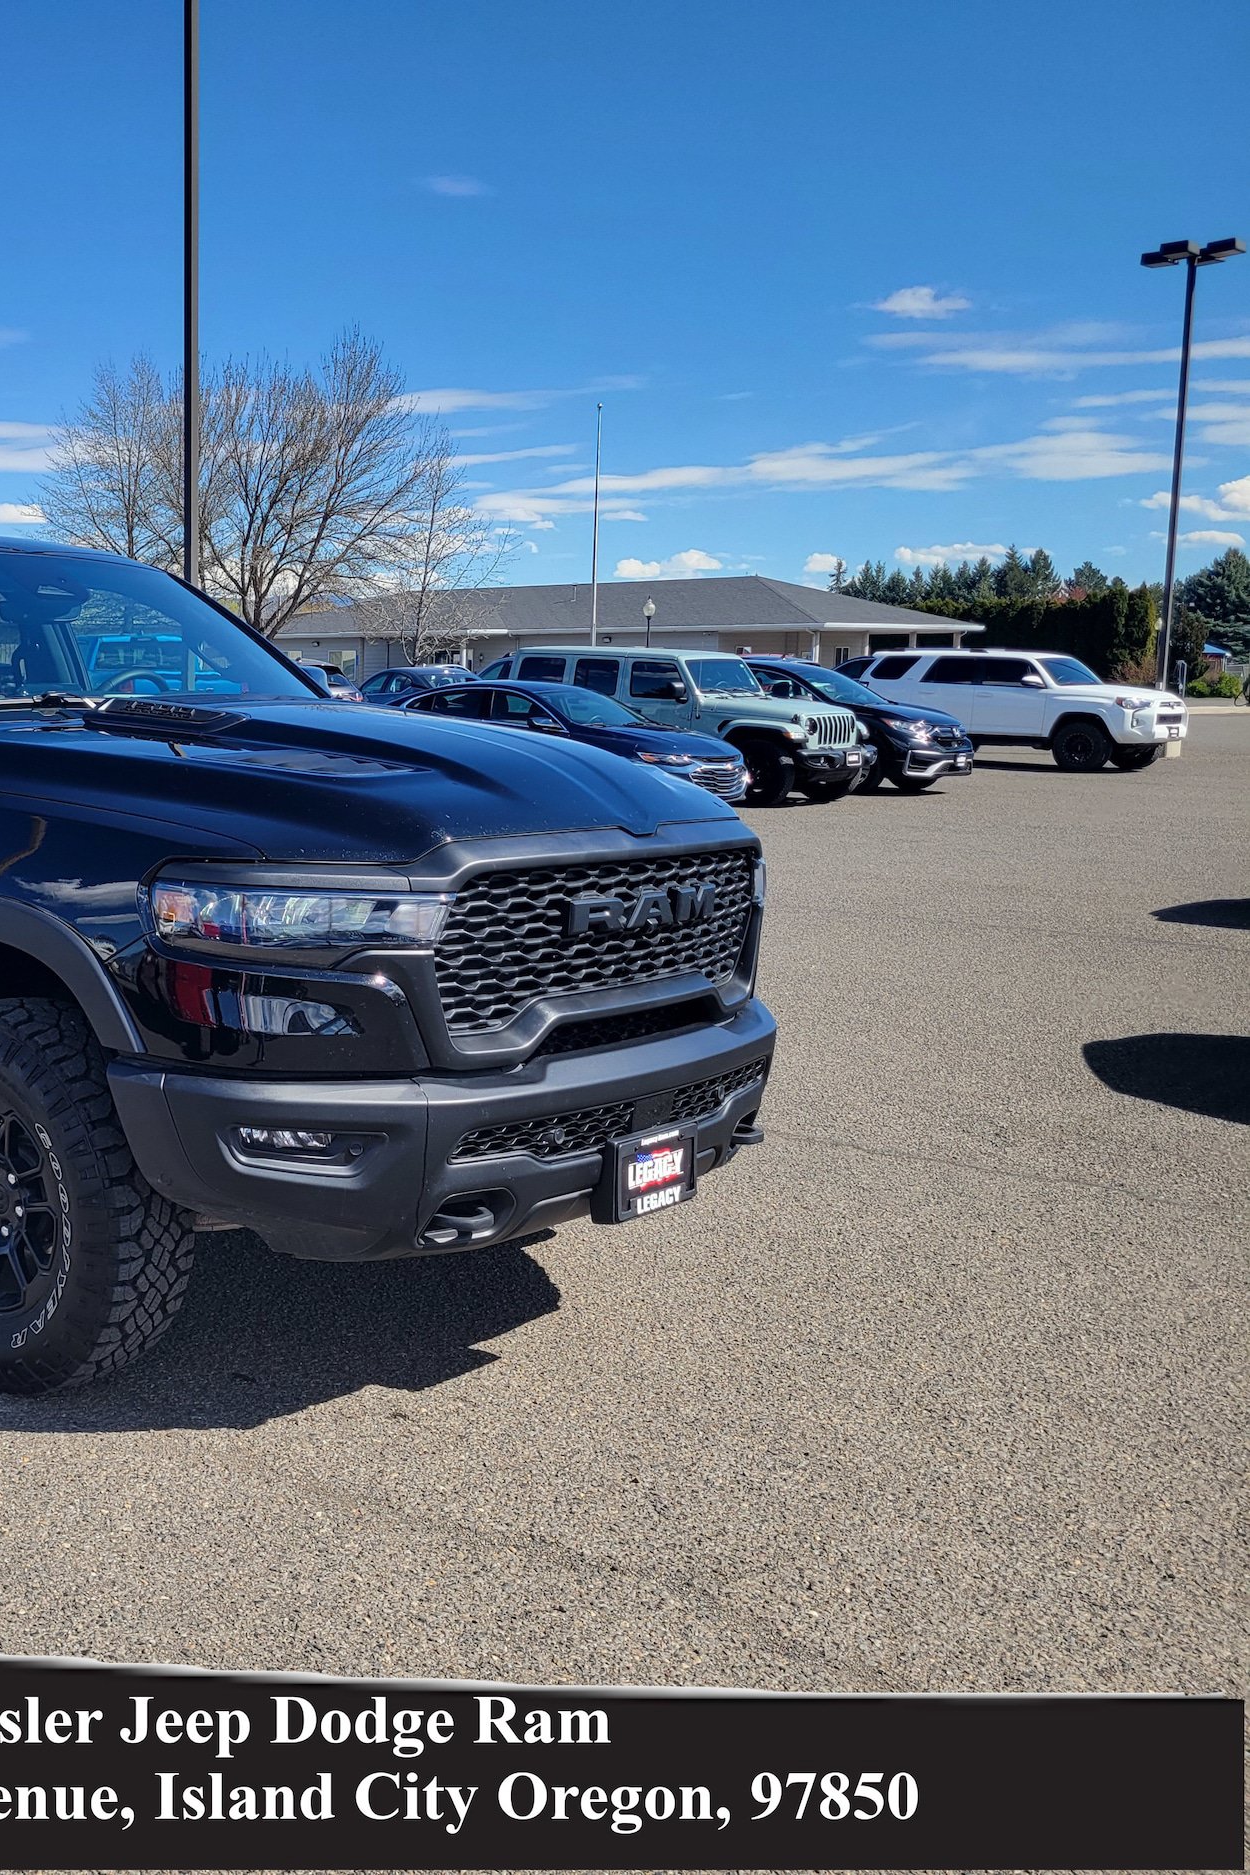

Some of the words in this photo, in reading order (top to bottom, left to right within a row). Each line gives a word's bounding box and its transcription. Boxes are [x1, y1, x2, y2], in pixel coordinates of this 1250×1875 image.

[568, 882, 717, 937] RAM
[628, 1148, 684, 1190] LEGACY
[636, 1185, 681, 1215] LEGACY
[11, 1122, 73, 1349] GOODYEAR
